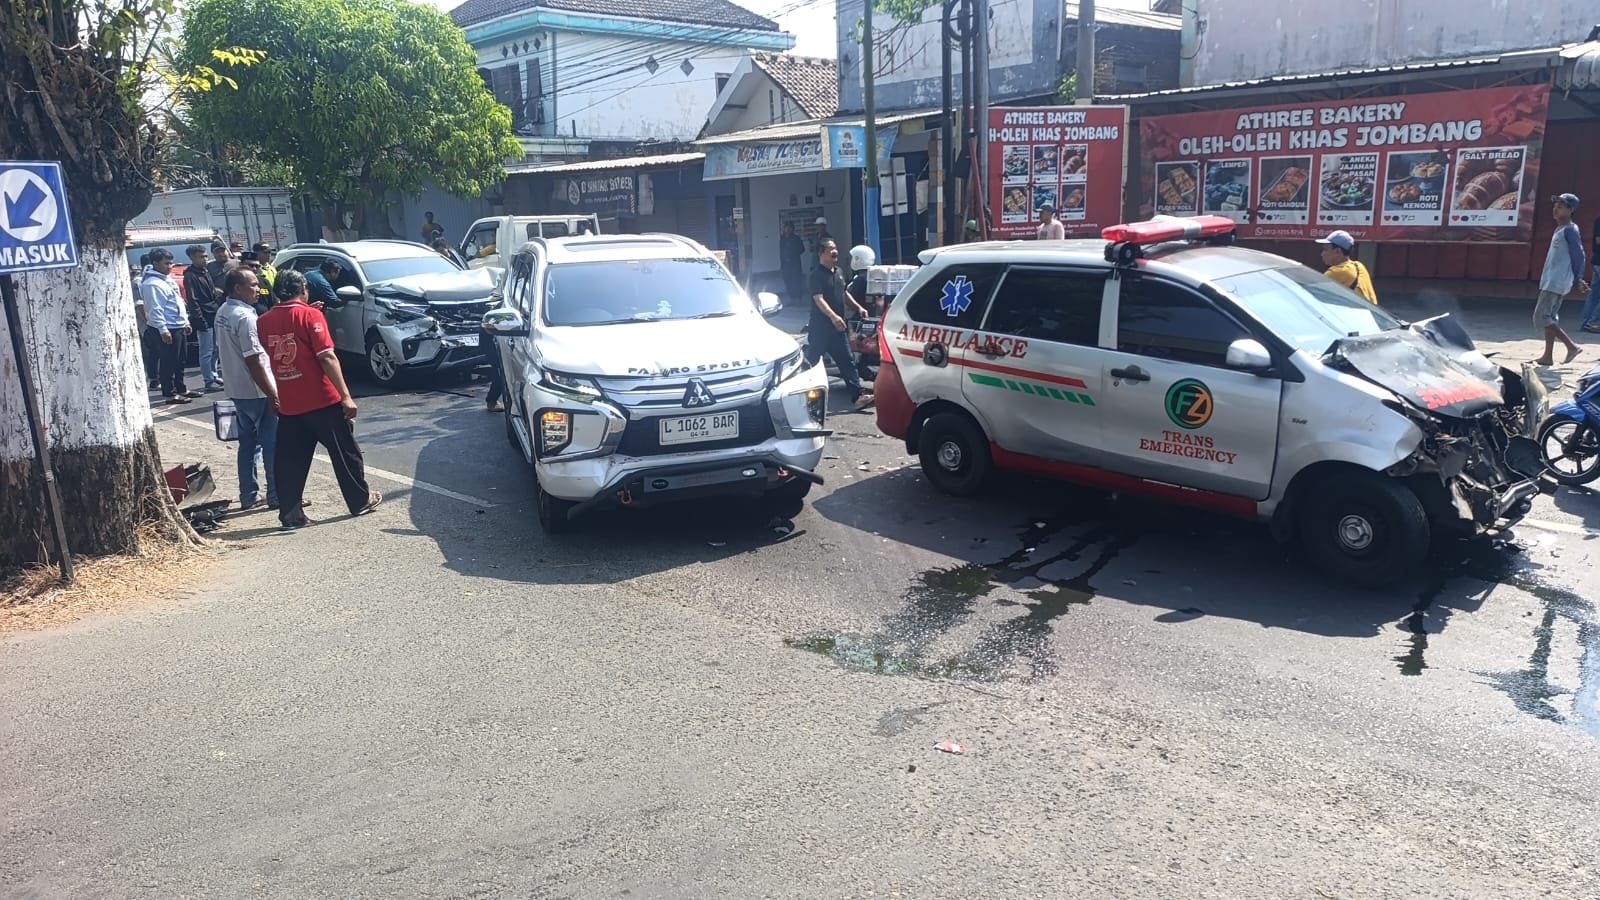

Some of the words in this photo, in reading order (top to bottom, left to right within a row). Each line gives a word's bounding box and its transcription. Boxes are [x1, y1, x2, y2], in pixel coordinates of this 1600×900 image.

[1003, 112, 1044, 125] ATHREE
[1046, 111, 1087, 124] BAKERY
[1235, 109, 1314, 131] ATHREE
[1319, 102, 1407, 125] BAKERY
[988, 127, 1029, 142] H-OLEH
[1031, 127, 1061, 141] KHAS
[1063, 126, 1119, 140] JOMBANG
[1178, 131, 1282, 156] OLEH-OLEH
[1288, 128, 1349, 150] KHAS
[1355, 119, 1483, 147] JOMBANG
[1463, 151, 1488, 160] SALT
[1488, 151, 1520, 160] BREAD
[0, 243, 70, 267] MASUK
[896, 323, 1029, 359] AMBULANCE
[697, 360, 750, 372] SPORT
[664, 421, 672, 434] L
[678, 418, 706, 433] 1062
[713, 415, 735, 429] BAR
[1162, 430, 1215, 448] TRANS
[1139, 438, 1237, 465] EMERGENCY
